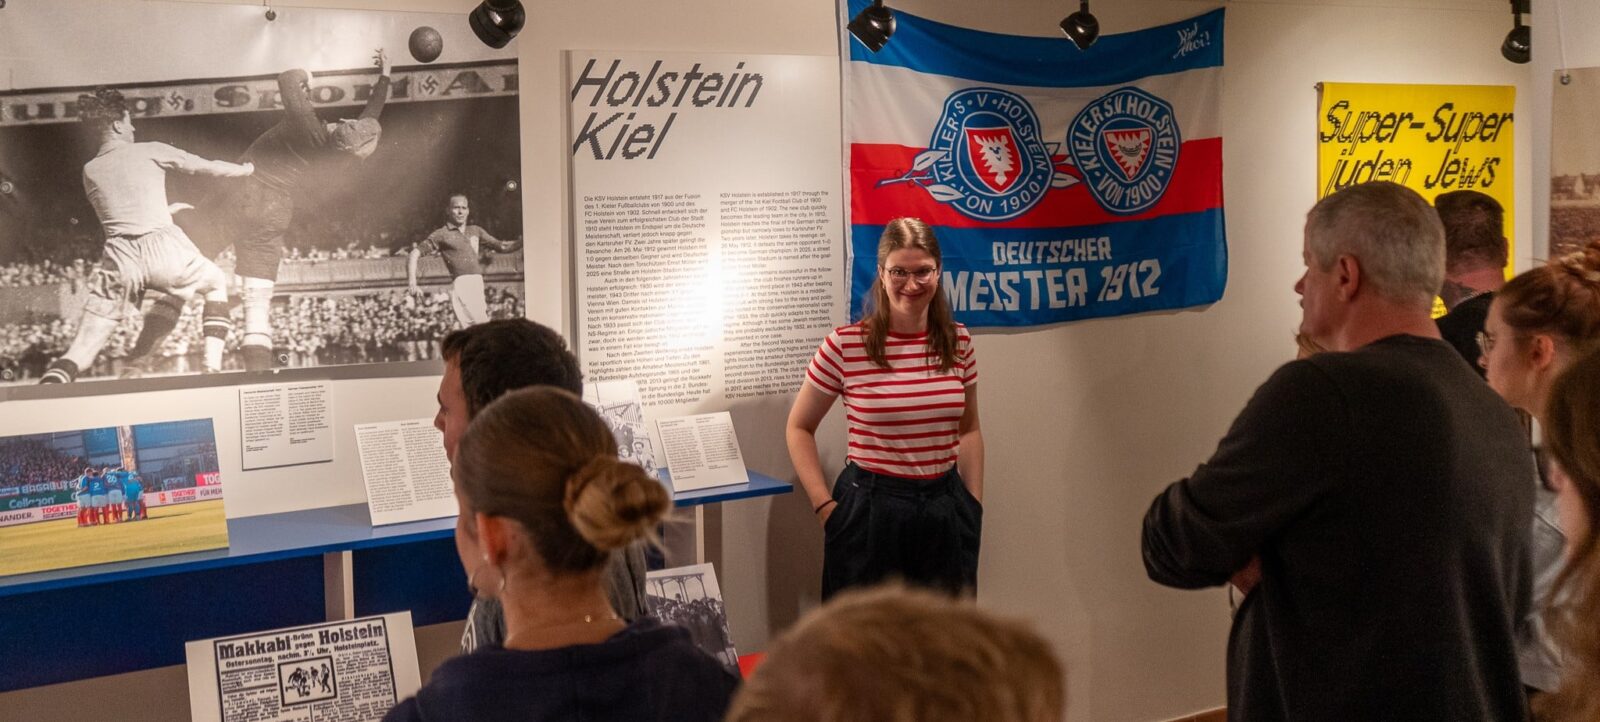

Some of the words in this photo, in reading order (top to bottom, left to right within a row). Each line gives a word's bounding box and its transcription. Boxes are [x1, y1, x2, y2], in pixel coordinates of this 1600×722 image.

[571, 59, 763, 107] Holstein
[573, 112, 678, 160] Kiel
[997, 97, 1049, 171] HOLSTEIN
[1075, 106, 1104, 170] KIELER
[1127, 95, 1175, 169] HOLSTEIN
[1097, 173, 1124, 206] VON
[1125, 174, 1162, 206] 1900
[1324, 149, 1412, 198] juden
[1424, 148, 1500, 189] Jews
[960, 186, 993, 214] ON
[1000, 181, 1040, 213] 1900
[992, 236, 1112, 266] DEUTSCHER
[942, 268, 1088, 312] MEISTER
[1097, 258, 1162, 301] 1912
[219, 635, 292, 660] Makkabi
[319, 624, 384, 646] Holstein
[295, 640, 316, 650] gegen
